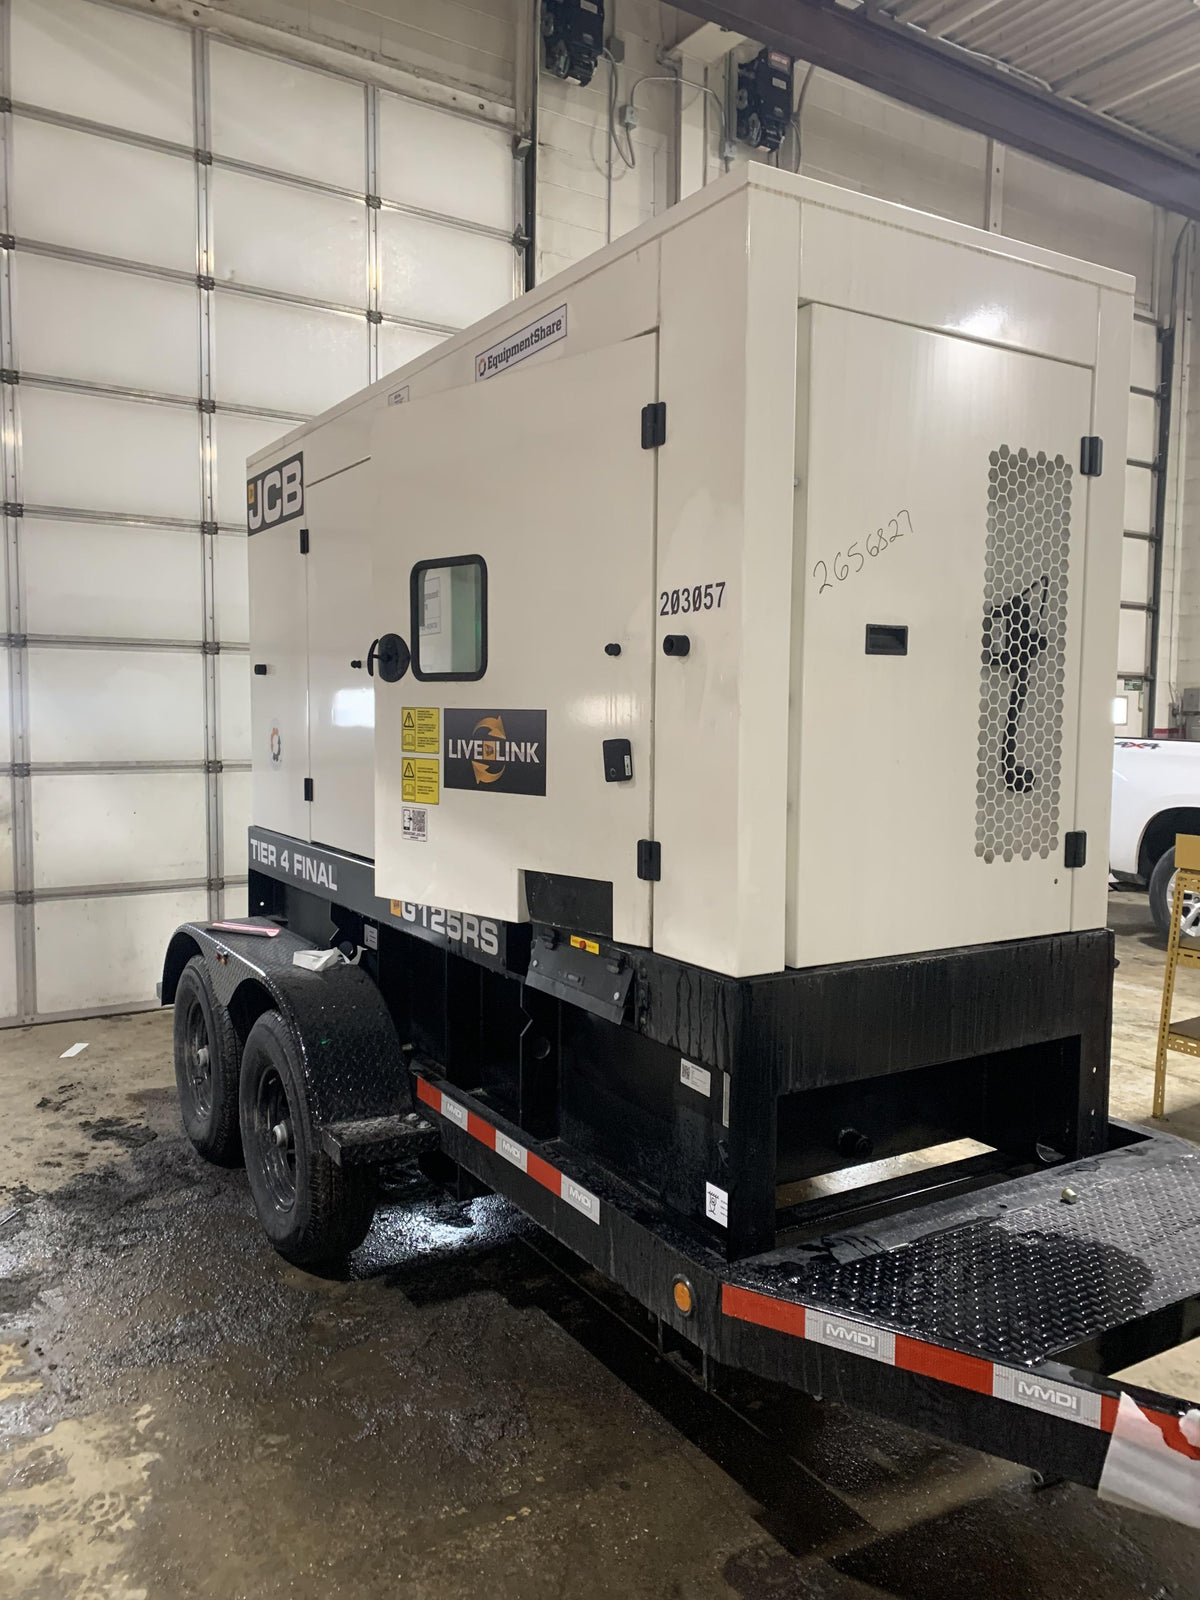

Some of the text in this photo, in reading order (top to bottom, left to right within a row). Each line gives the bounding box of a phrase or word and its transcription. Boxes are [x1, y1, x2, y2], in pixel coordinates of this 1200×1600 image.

[487, 319, 562, 370] EquipmentShare
[249, 460, 302, 530] JCB
[813, 509, 913, 595] 2656827
[660, 582, 726, 616] 203057
[250, 839, 338, 891] TIER 4 FINAL
